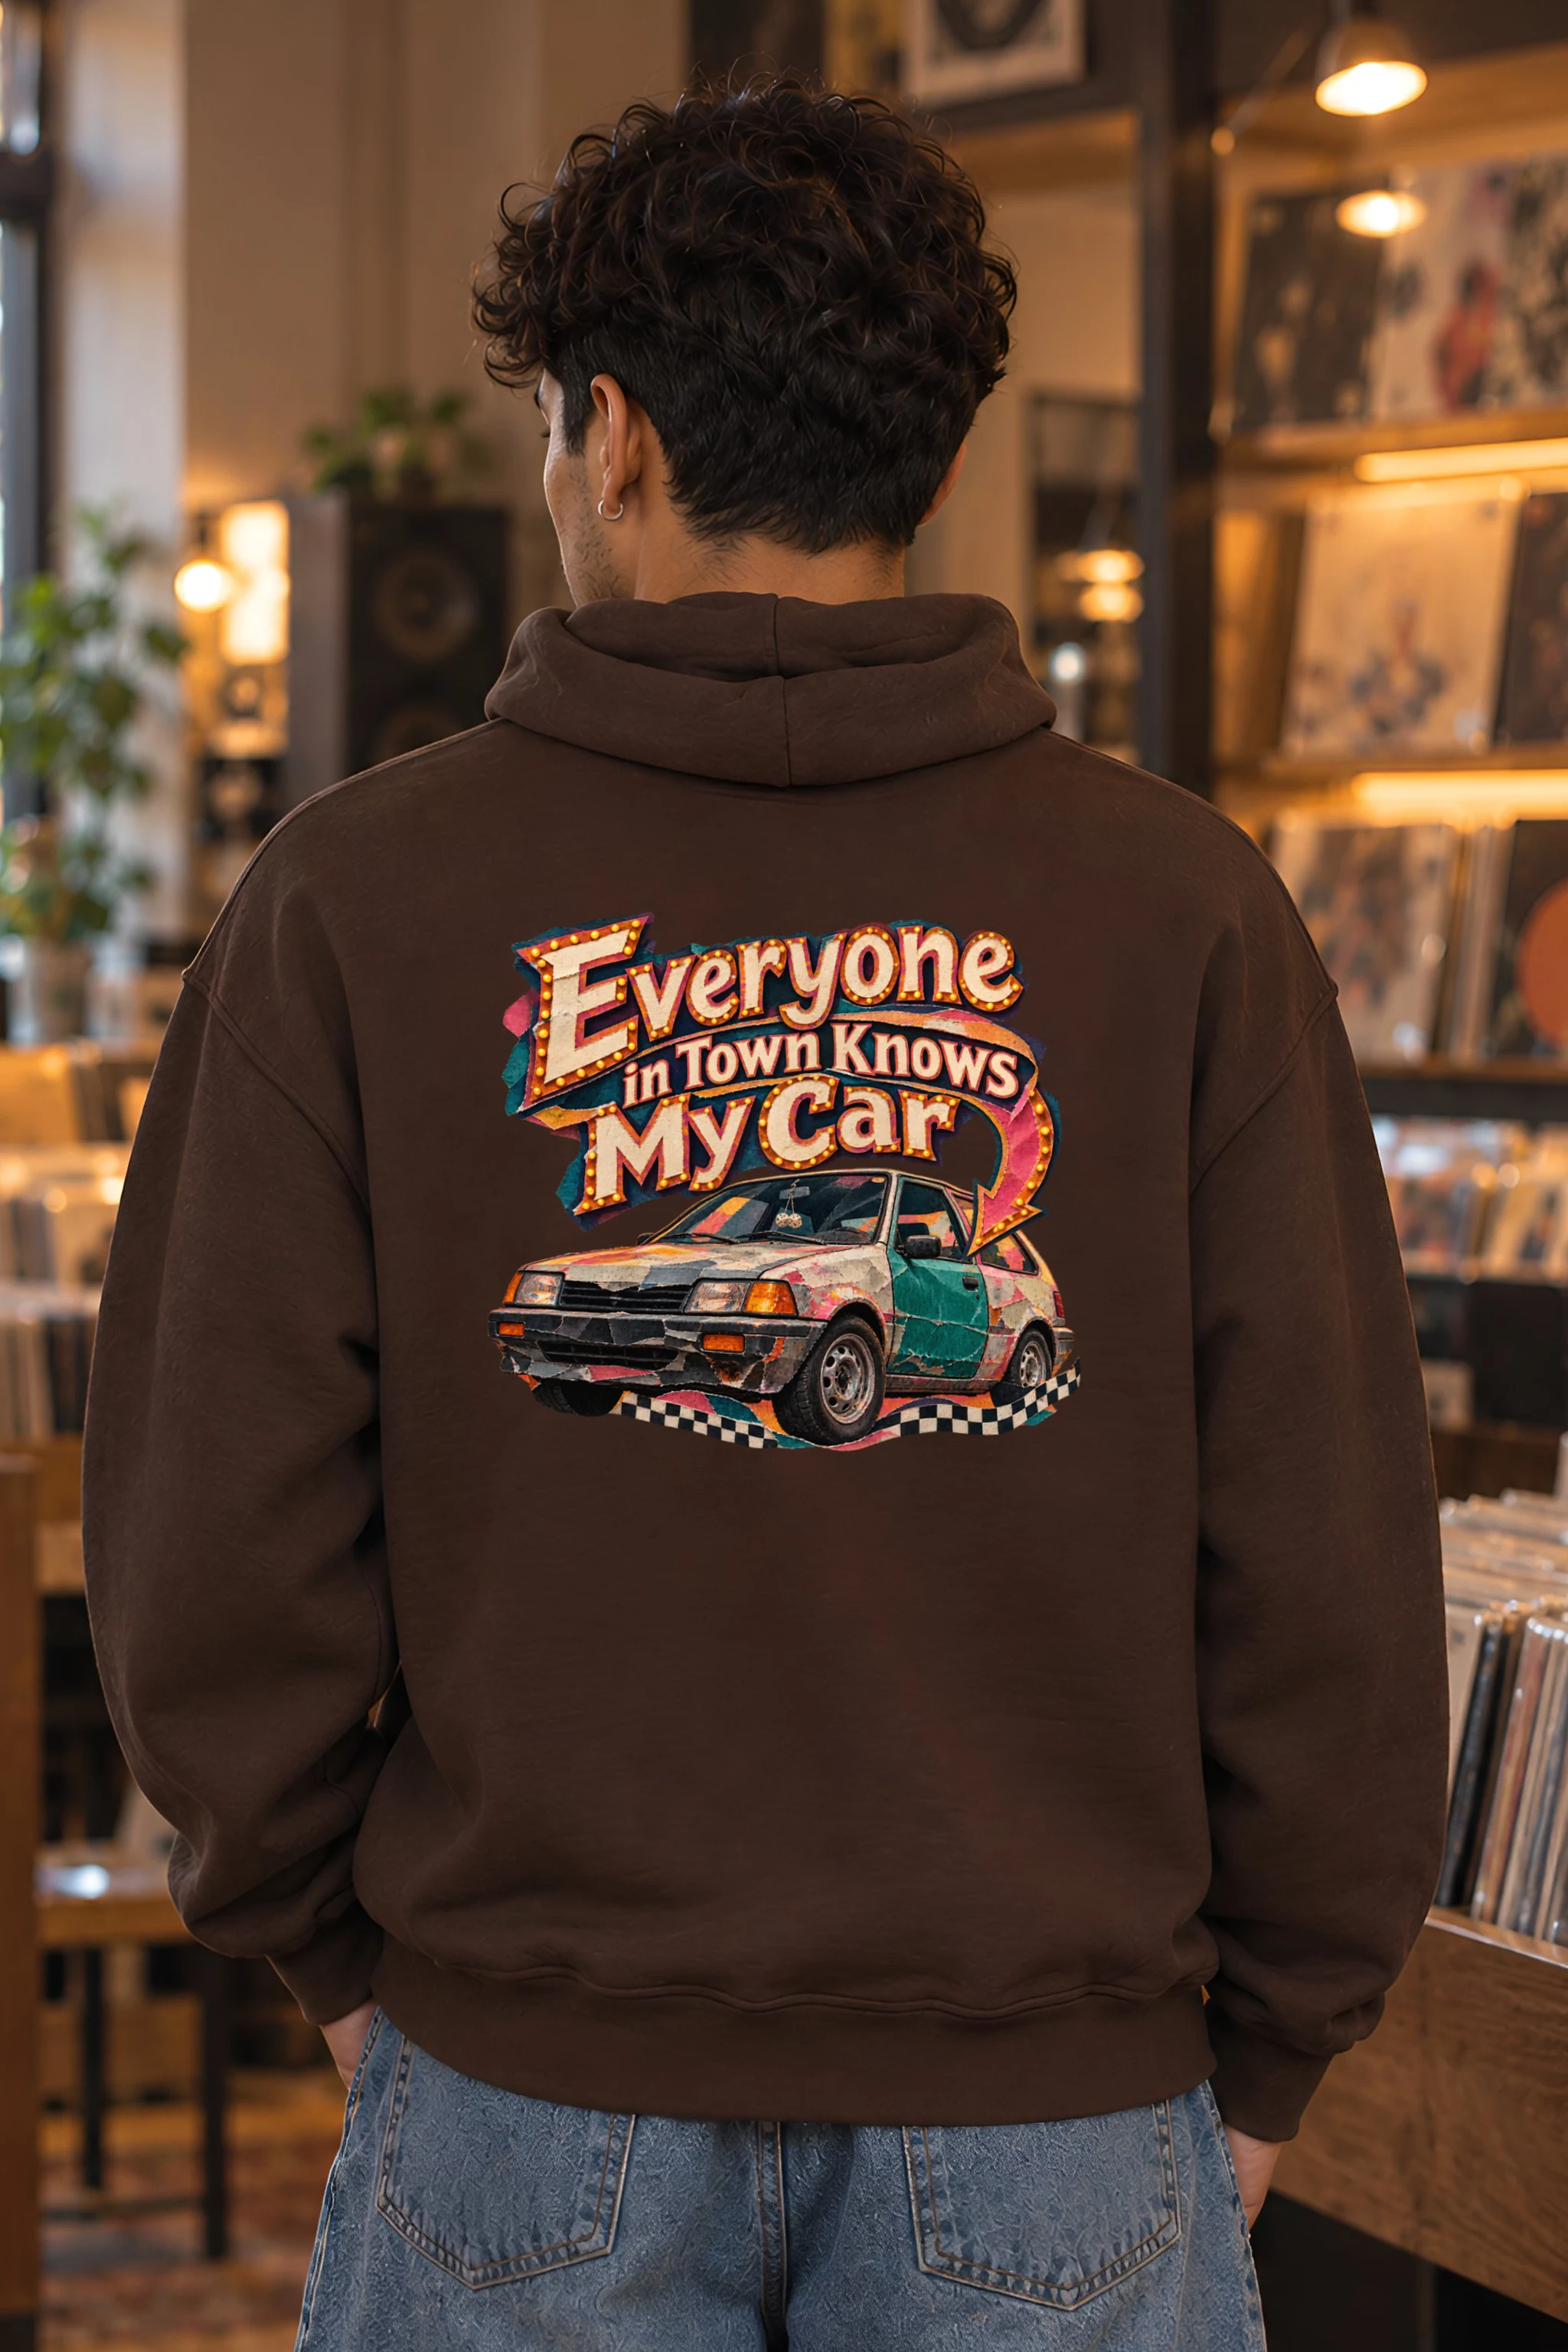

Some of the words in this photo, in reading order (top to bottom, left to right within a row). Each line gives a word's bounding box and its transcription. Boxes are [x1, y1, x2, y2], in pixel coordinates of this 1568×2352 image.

[516, 916, 1024, 1102] Everyone
[622, 1062, 672, 1109] in
[675, 1031, 821, 1090] Town
[830, 1022, 1019, 1099] Knows
[573, 1093, 756, 1215] My
[758, 1073, 962, 1170] Car
